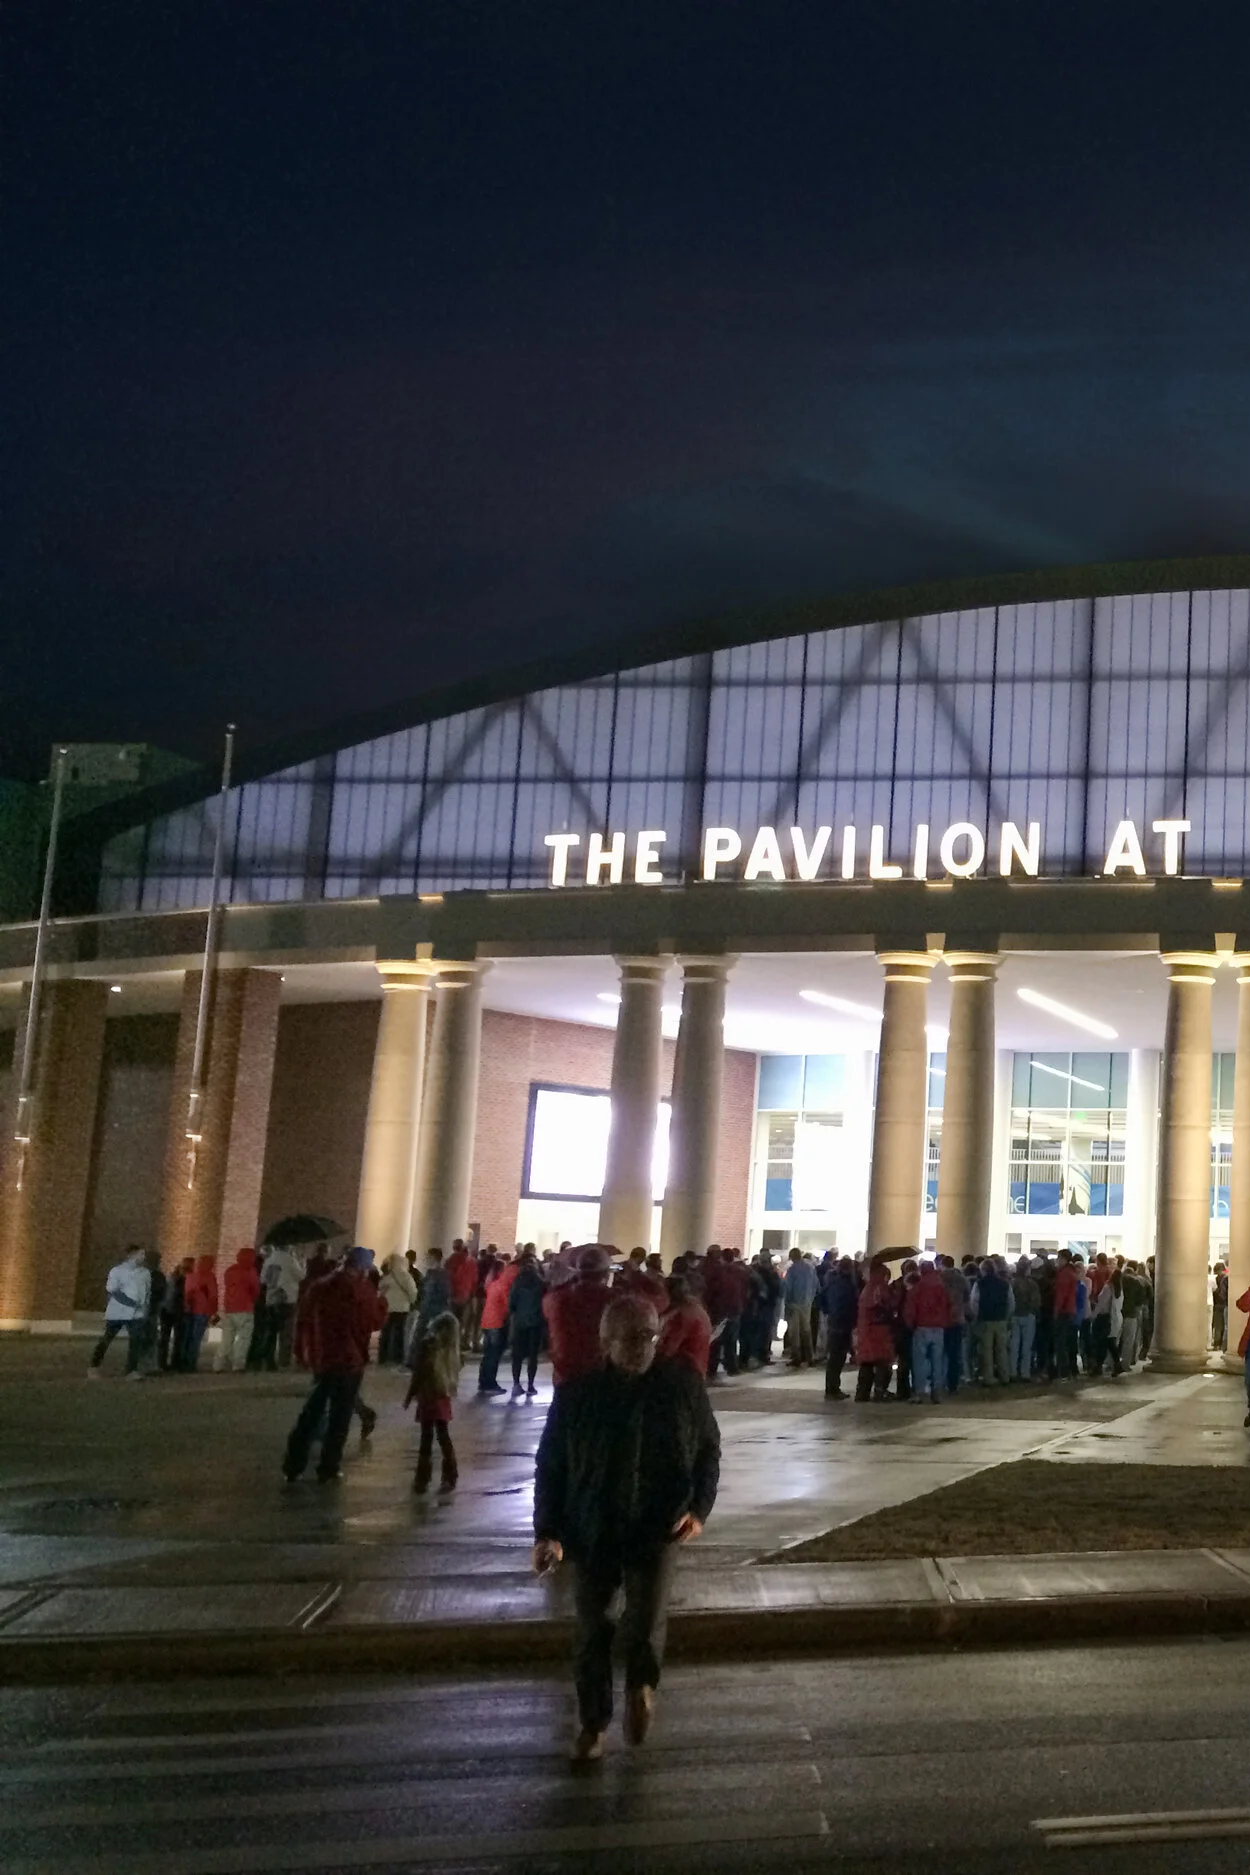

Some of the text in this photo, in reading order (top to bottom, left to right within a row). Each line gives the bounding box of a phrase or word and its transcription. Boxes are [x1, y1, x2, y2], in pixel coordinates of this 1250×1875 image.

[544, 830, 667, 886] THE
[703, 821, 1041, 881] PAVILION
[1103, 820, 1192, 877] AT
